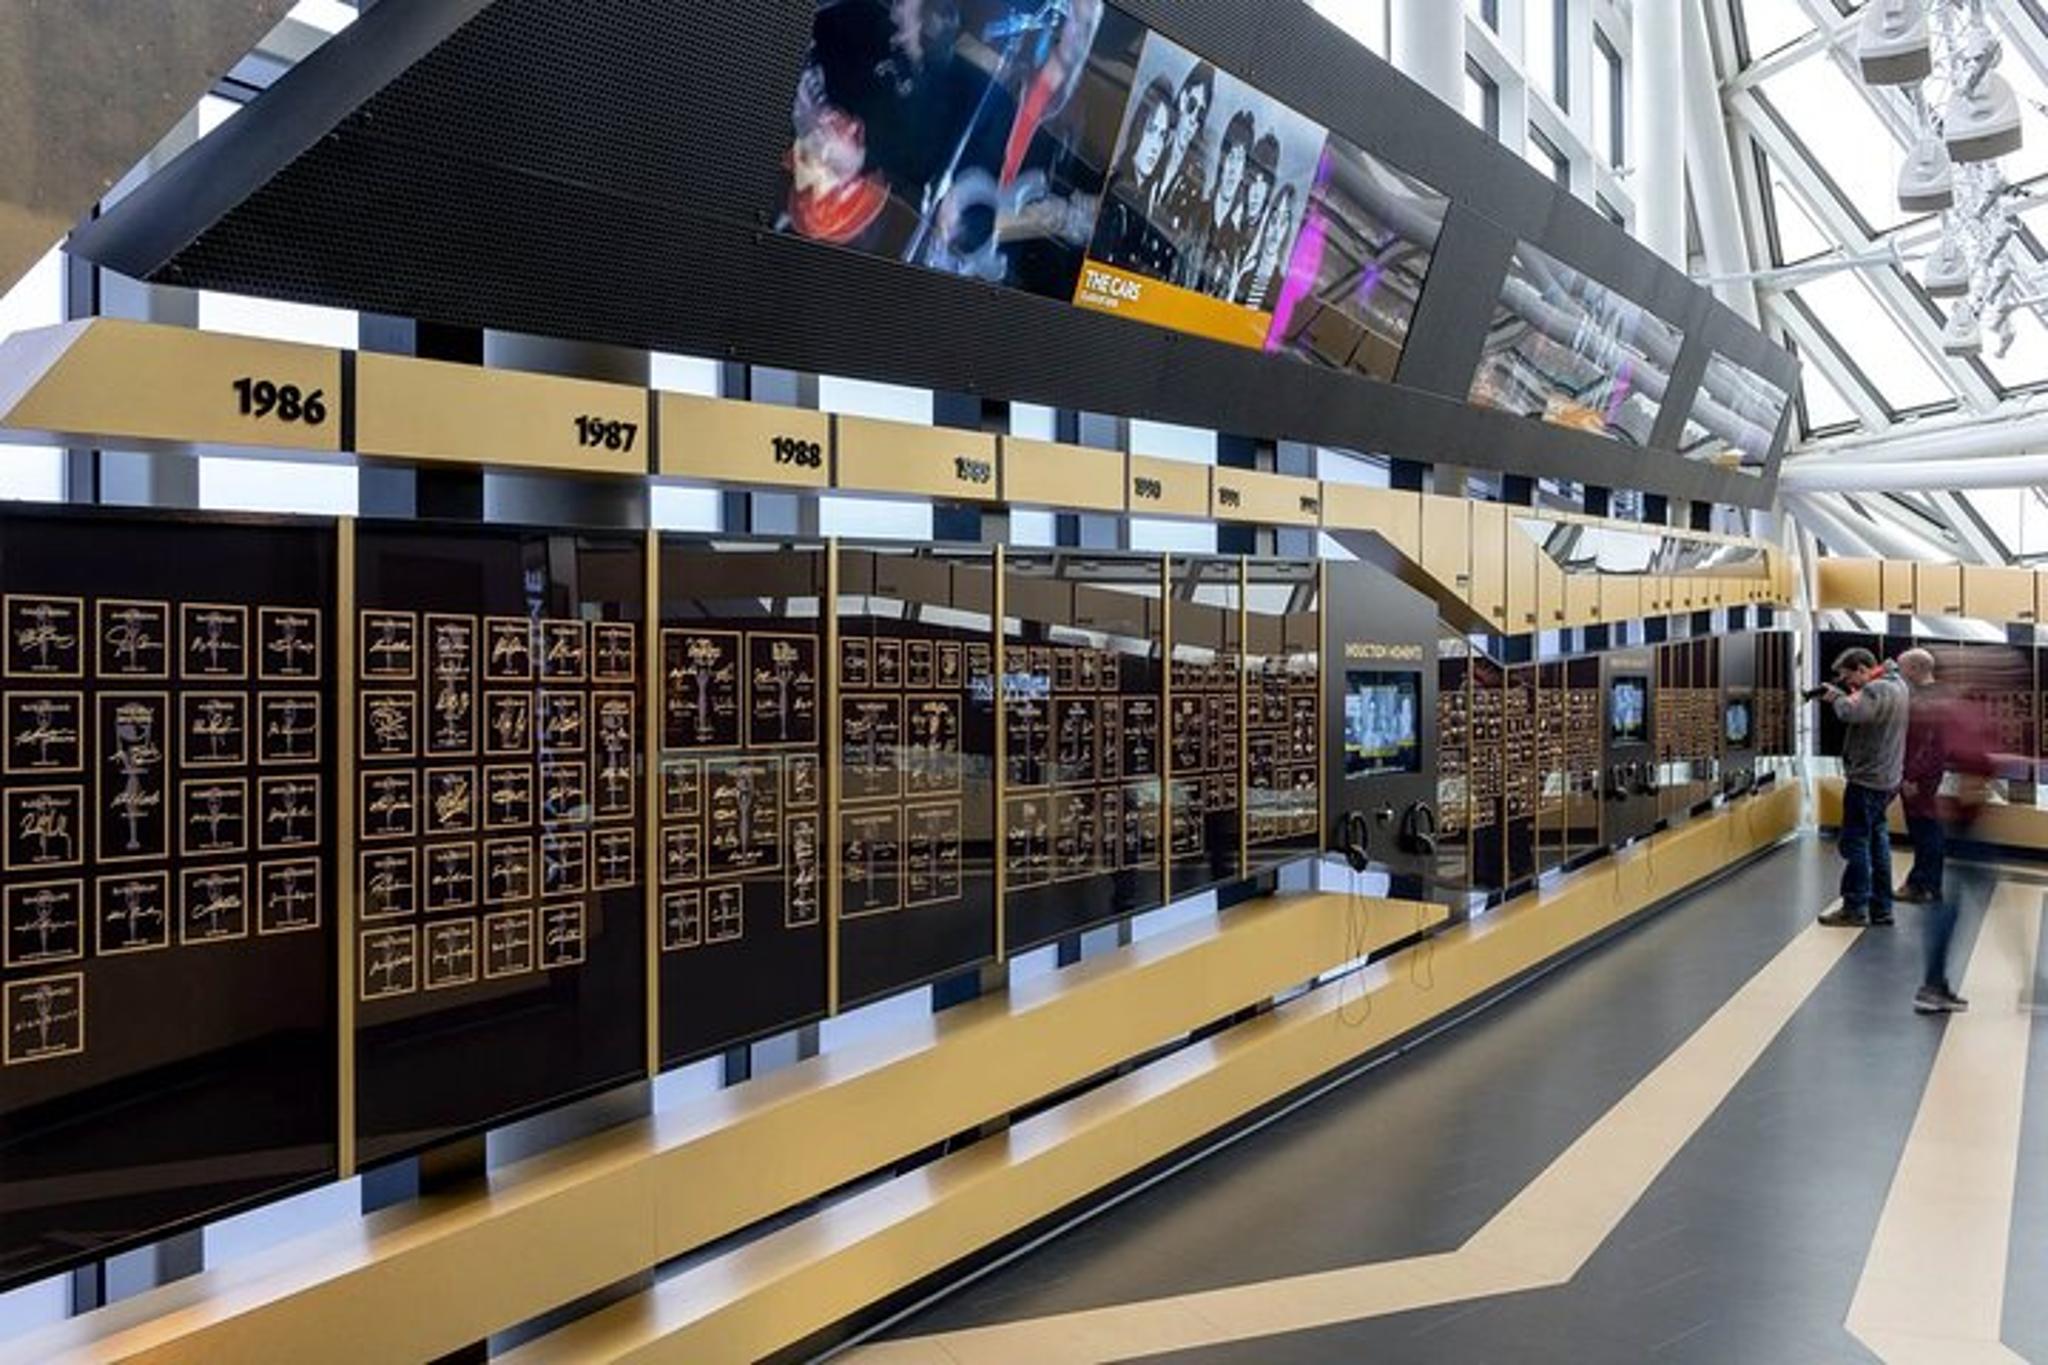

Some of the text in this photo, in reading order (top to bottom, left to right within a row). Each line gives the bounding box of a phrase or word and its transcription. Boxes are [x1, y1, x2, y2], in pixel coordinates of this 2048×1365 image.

[1085, 269, 1112, 294] THE
[1110, 277, 1142, 303] CARS
[233, 377, 325, 425] 1986
[574, 414, 638, 453] 1987
[771, 436, 822, 469] 1988
